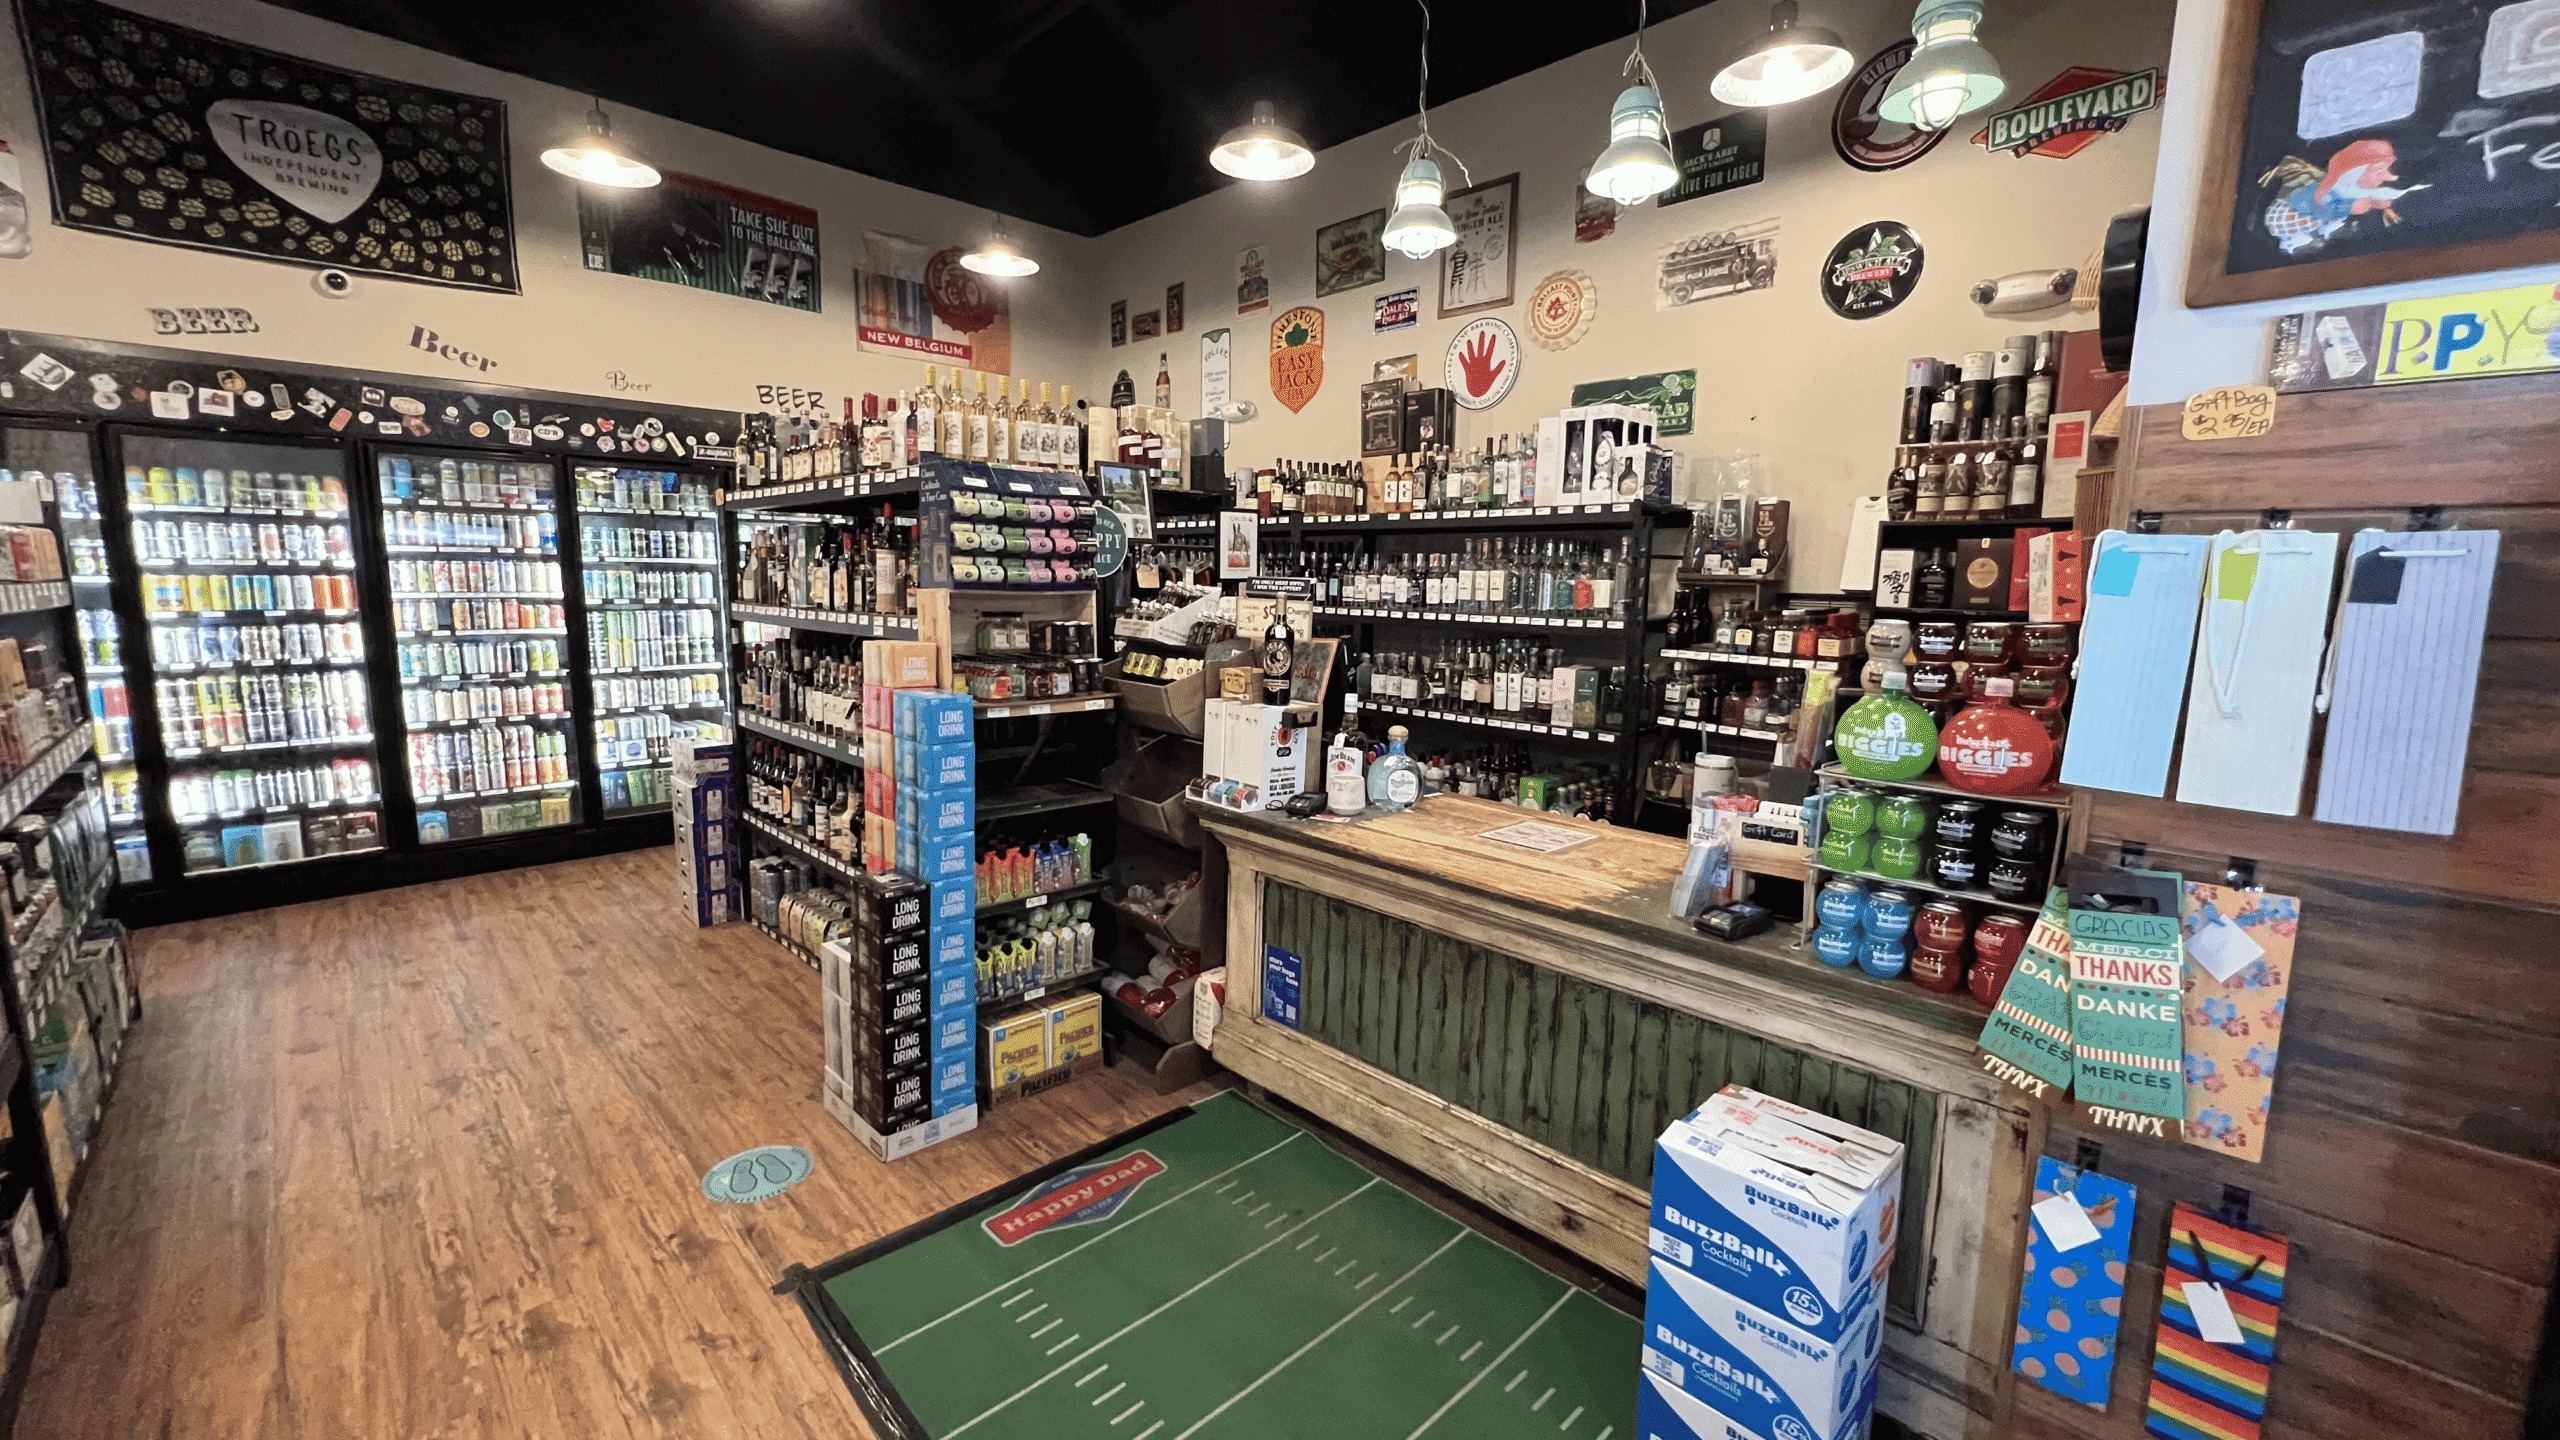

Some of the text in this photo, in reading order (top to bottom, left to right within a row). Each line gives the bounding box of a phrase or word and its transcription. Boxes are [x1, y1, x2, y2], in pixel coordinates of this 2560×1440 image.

[1994, 77, 2150, 145] BOULEVARD
[2017, 118, 2097, 156] BREWING
[243, 151, 361, 183] INDEPENDENT
[275, 172, 349, 196] BREWING
[1680, 178, 1701, 195] LIVE
[1704, 171, 1723, 188] FOR
[1727, 162, 1759, 183] LAGER
[730, 206, 815, 243] TAKE SUE OUT
[730, 225, 743, 240] TO
[746, 228, 763, 245] THE
[145, 307, 261, 336] BEER
[407, 322, 499, 374] Beer
[867, 330, 964, 357] NEW BELGIUM
[1277, 350, 1317, 373] EASY
[605, 370, 653, 393] Beer
[1278, 369, 1315, 390] JACK
[755, 384, 827, 411] BEER
[1096, 532, 1122, 549] PPY
[1094, 553, 1112, 564] ACE
[902, 656, 928, 668] LONG
[902, 668, 928, 681] DRINK
[939, 709, 964, 724] LONG
[938, 723, 965, 737] DRINK
[1837, 733, 1925, 757] BIGGIES
[941, 755, 965, 770] LONG
[1940, 745, 2033, 769] BIGGIES
[940, 769, 967, 784] DRINK
[941, 801, 965, 816] LONG
[938, 814, 965, 829] DRINK
[1742, 823, 1794, 840] Gift Card
[941, 846, 965, 861] LONG
[940, 859, 966, 874] DRINK
[894, 898, 920, 916] LONG
[943, 889, 966, 905] LONG
[940, 901, 966, 918] DRINK
[892, 911, 921, 930] DRINK
[2074, 913, 2171, 940] GRACIAS
[941, 933, 965, 950] LONG
[2074, 940, 2176, 961] MERCI
[893, 943, 919, 961] LONG
[939, 945, 966, 963] DRINK
[893, 957, 921, 976] DRINK
[2018, 957, 2071, 994] DAN
[2075, 955, 2173, 986] THANKS
[942, 976, 966, 994] LONG
[896, 989, 921, 1007] LONG
[940, 989, 966, 1007] DRINK
[2076, 993, 2178, 1023] DANKE
[893, 1003, 922, 1021] DRINK
[942, 1018, 966, 1036] LONG
[895, 1032, 920, 1051] LONG
[941, 1031, 967, 1050] DRINK
[1994, 1017, 2071, 1062] MERCÈS
[893, 1045, 921, 1065] DRINK
[942, 1061, 966, 1079] LONG
[1983, 1053, 2049, 1099] THNX
[2081, 1063, 2172, 1091] MERCÈS
[896, 1076, 920, 1096] LONG
[940, 1073, 966, 1091] DRINK
[894, 1089, 922, 1108] DRINK
[2088, 1105, 2165, 1138] THNX
[1002, 1159, 1148, 1233] Happy Dad
[1745, 1184, 1838, 1231] BuzzBallz
[1771, 1206, 1808, 1229] Cocktails
[1664, 1204, 1792, 1278] BuzzBallz
[1701, 1239, 1752, 1273] Cocktails
[1735, 1310, 1825, 1363] BuzzBallz
[1760, 1334, 1798, 1359] Cocktails
[1656, 1323, 1781, 1405] BuzzBallz
[1692, 1361, 1742, 1397] Cocktails
